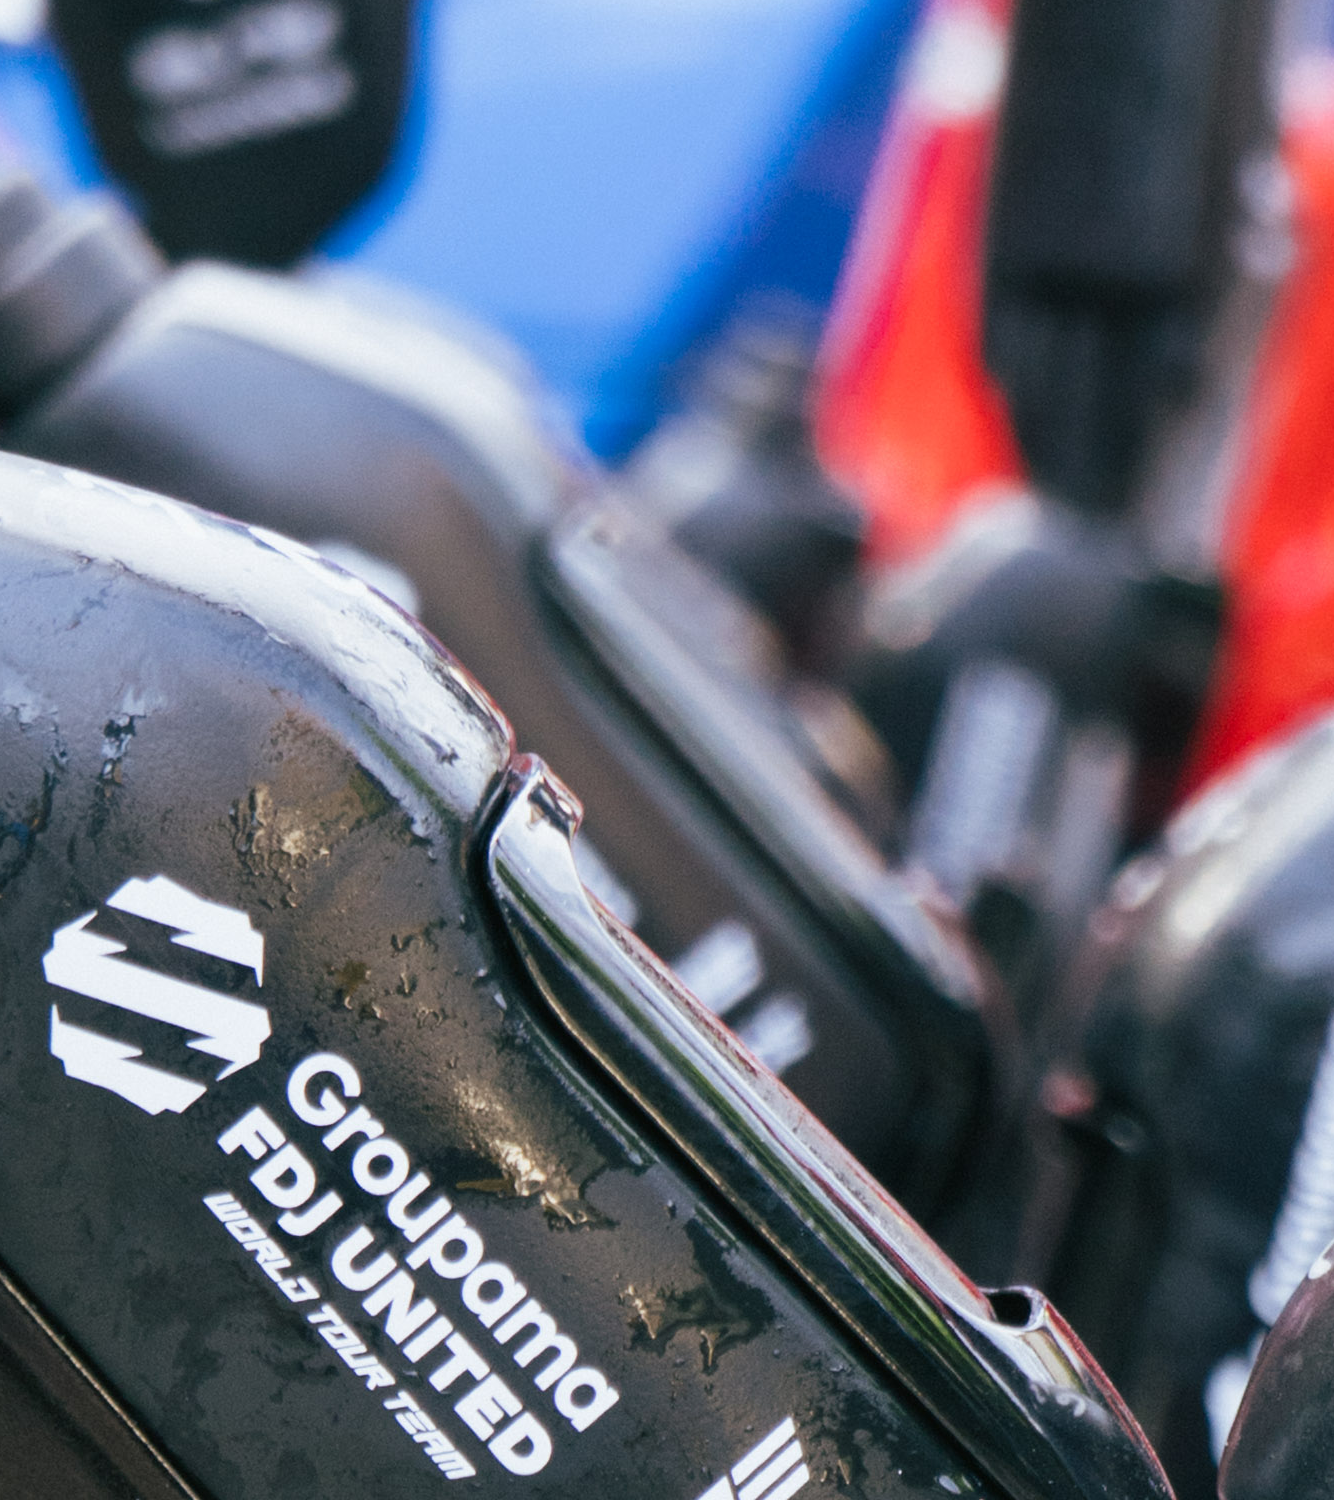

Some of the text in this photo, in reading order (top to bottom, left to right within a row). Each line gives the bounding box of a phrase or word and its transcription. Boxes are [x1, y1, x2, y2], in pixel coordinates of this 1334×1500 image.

[202, 1192, 477, 1480] WORLD TOUR TEAM
[216, 1106, 553, 1477] FDJ UNITED
[286, 1052, 619, 1433] Groupama
